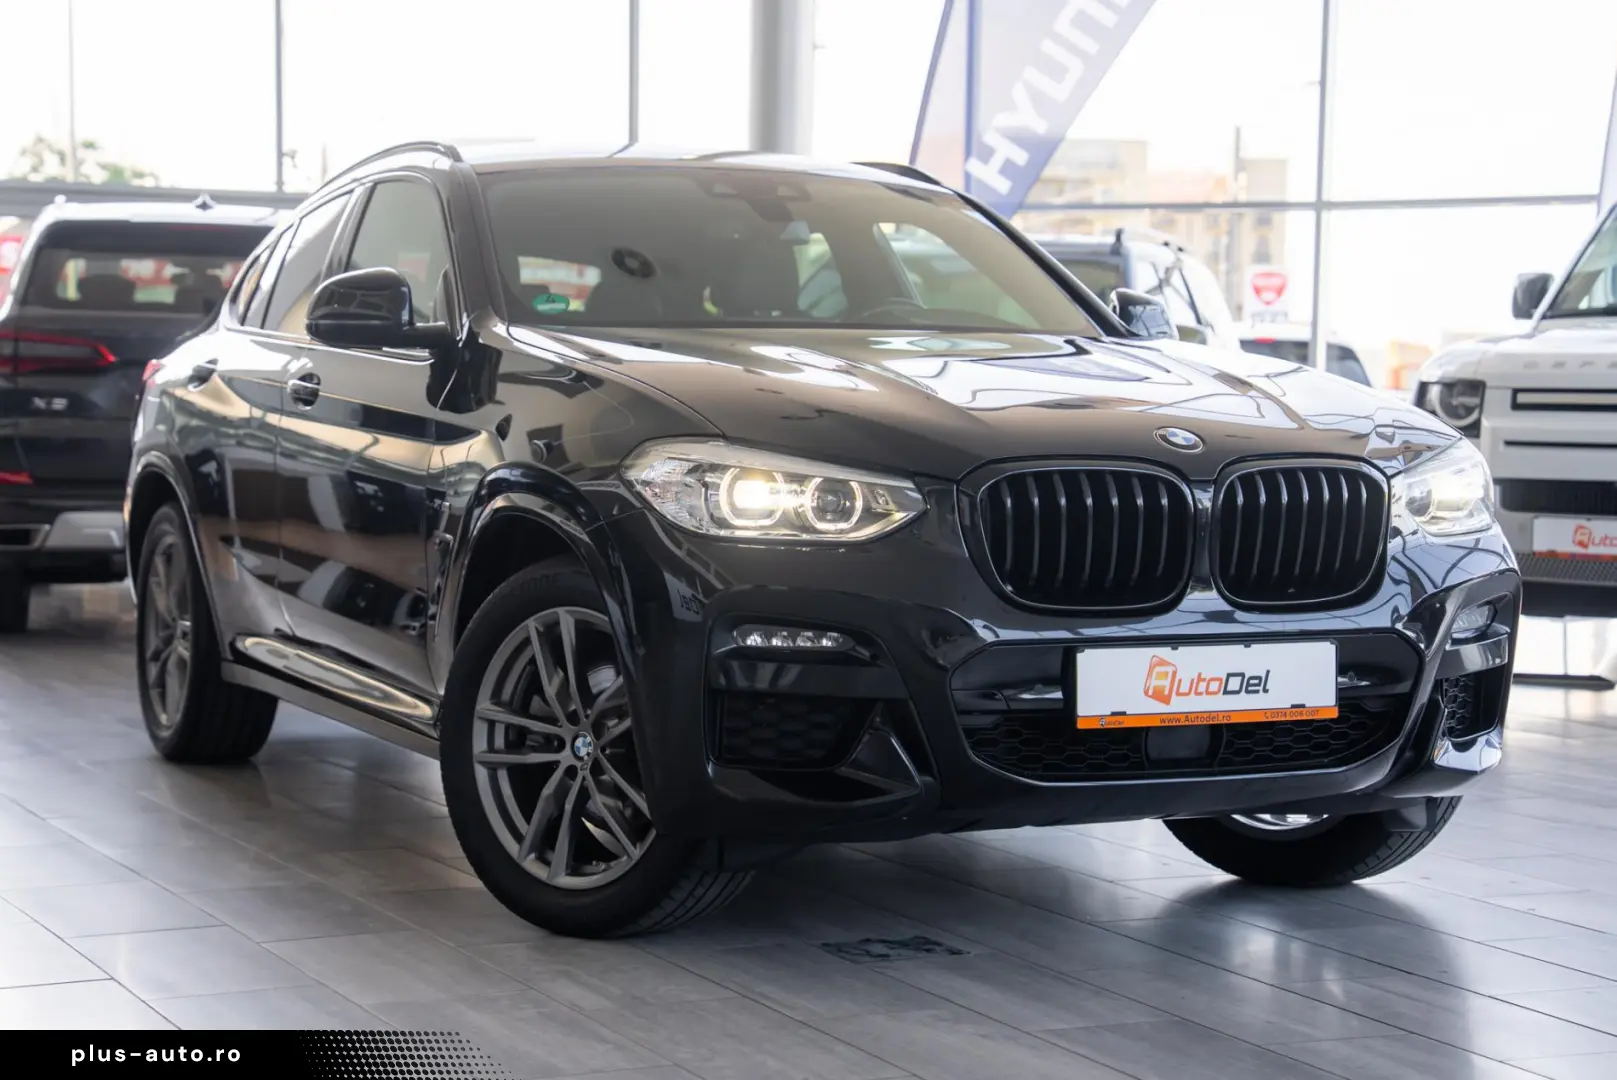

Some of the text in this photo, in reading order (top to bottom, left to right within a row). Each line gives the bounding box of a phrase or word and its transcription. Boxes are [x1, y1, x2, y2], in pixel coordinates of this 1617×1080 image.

[965, 0, 1136, 196] HYUN
[1144, 655, 1270, 705] AutoDel
[1160, 713, 1231, 724] www.Autodel.ro
